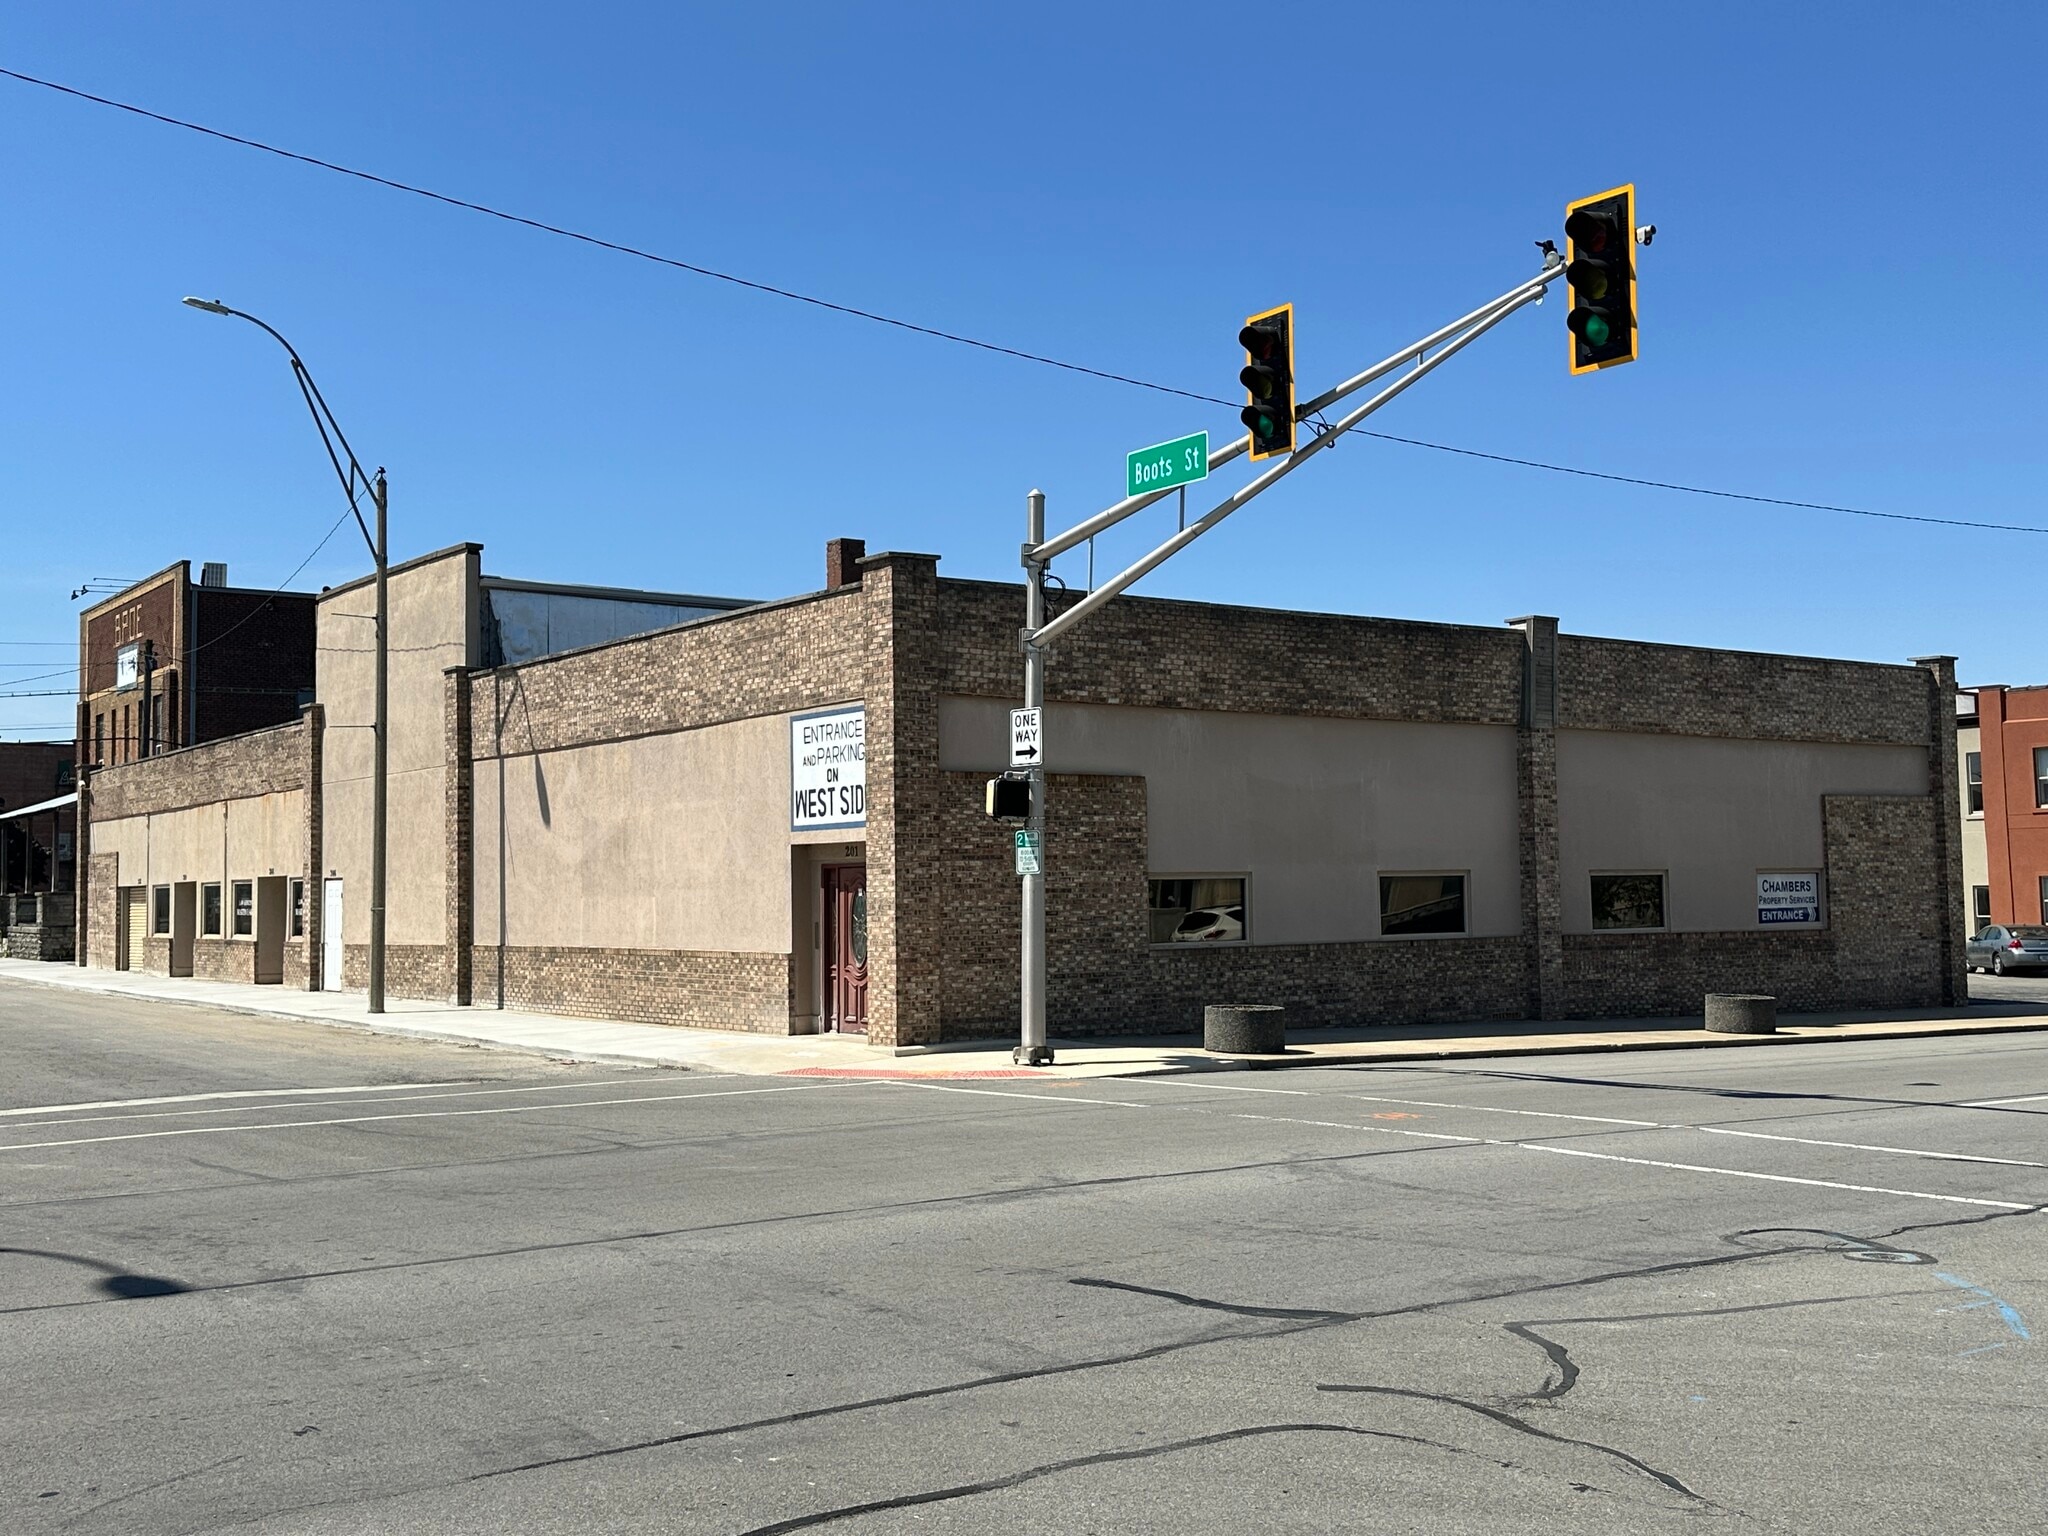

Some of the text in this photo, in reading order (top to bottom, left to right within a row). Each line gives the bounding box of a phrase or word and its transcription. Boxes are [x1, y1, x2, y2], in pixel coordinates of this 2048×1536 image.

[1135, 446, 1199, 485] Boots St
[1015, 713, 1037, 728] ONE
[803, 719, 863, 745] ENTRANCE
[1015, 728, 1038, 743] WAY
[802, 742, 866, 767] AND PARKING
[826, 767, 839, 783] ON
[795, 784, 867, 819] WEST SID
[1017, 833, 1024, 846] 2
[845, 845, 859, 857] 201
[1762, 879, 1811, 893] CHAMBERS
[1758, 895, 1788, 905] PROPERTY
[1761, 910, 1804, 921] ENTRANCE
